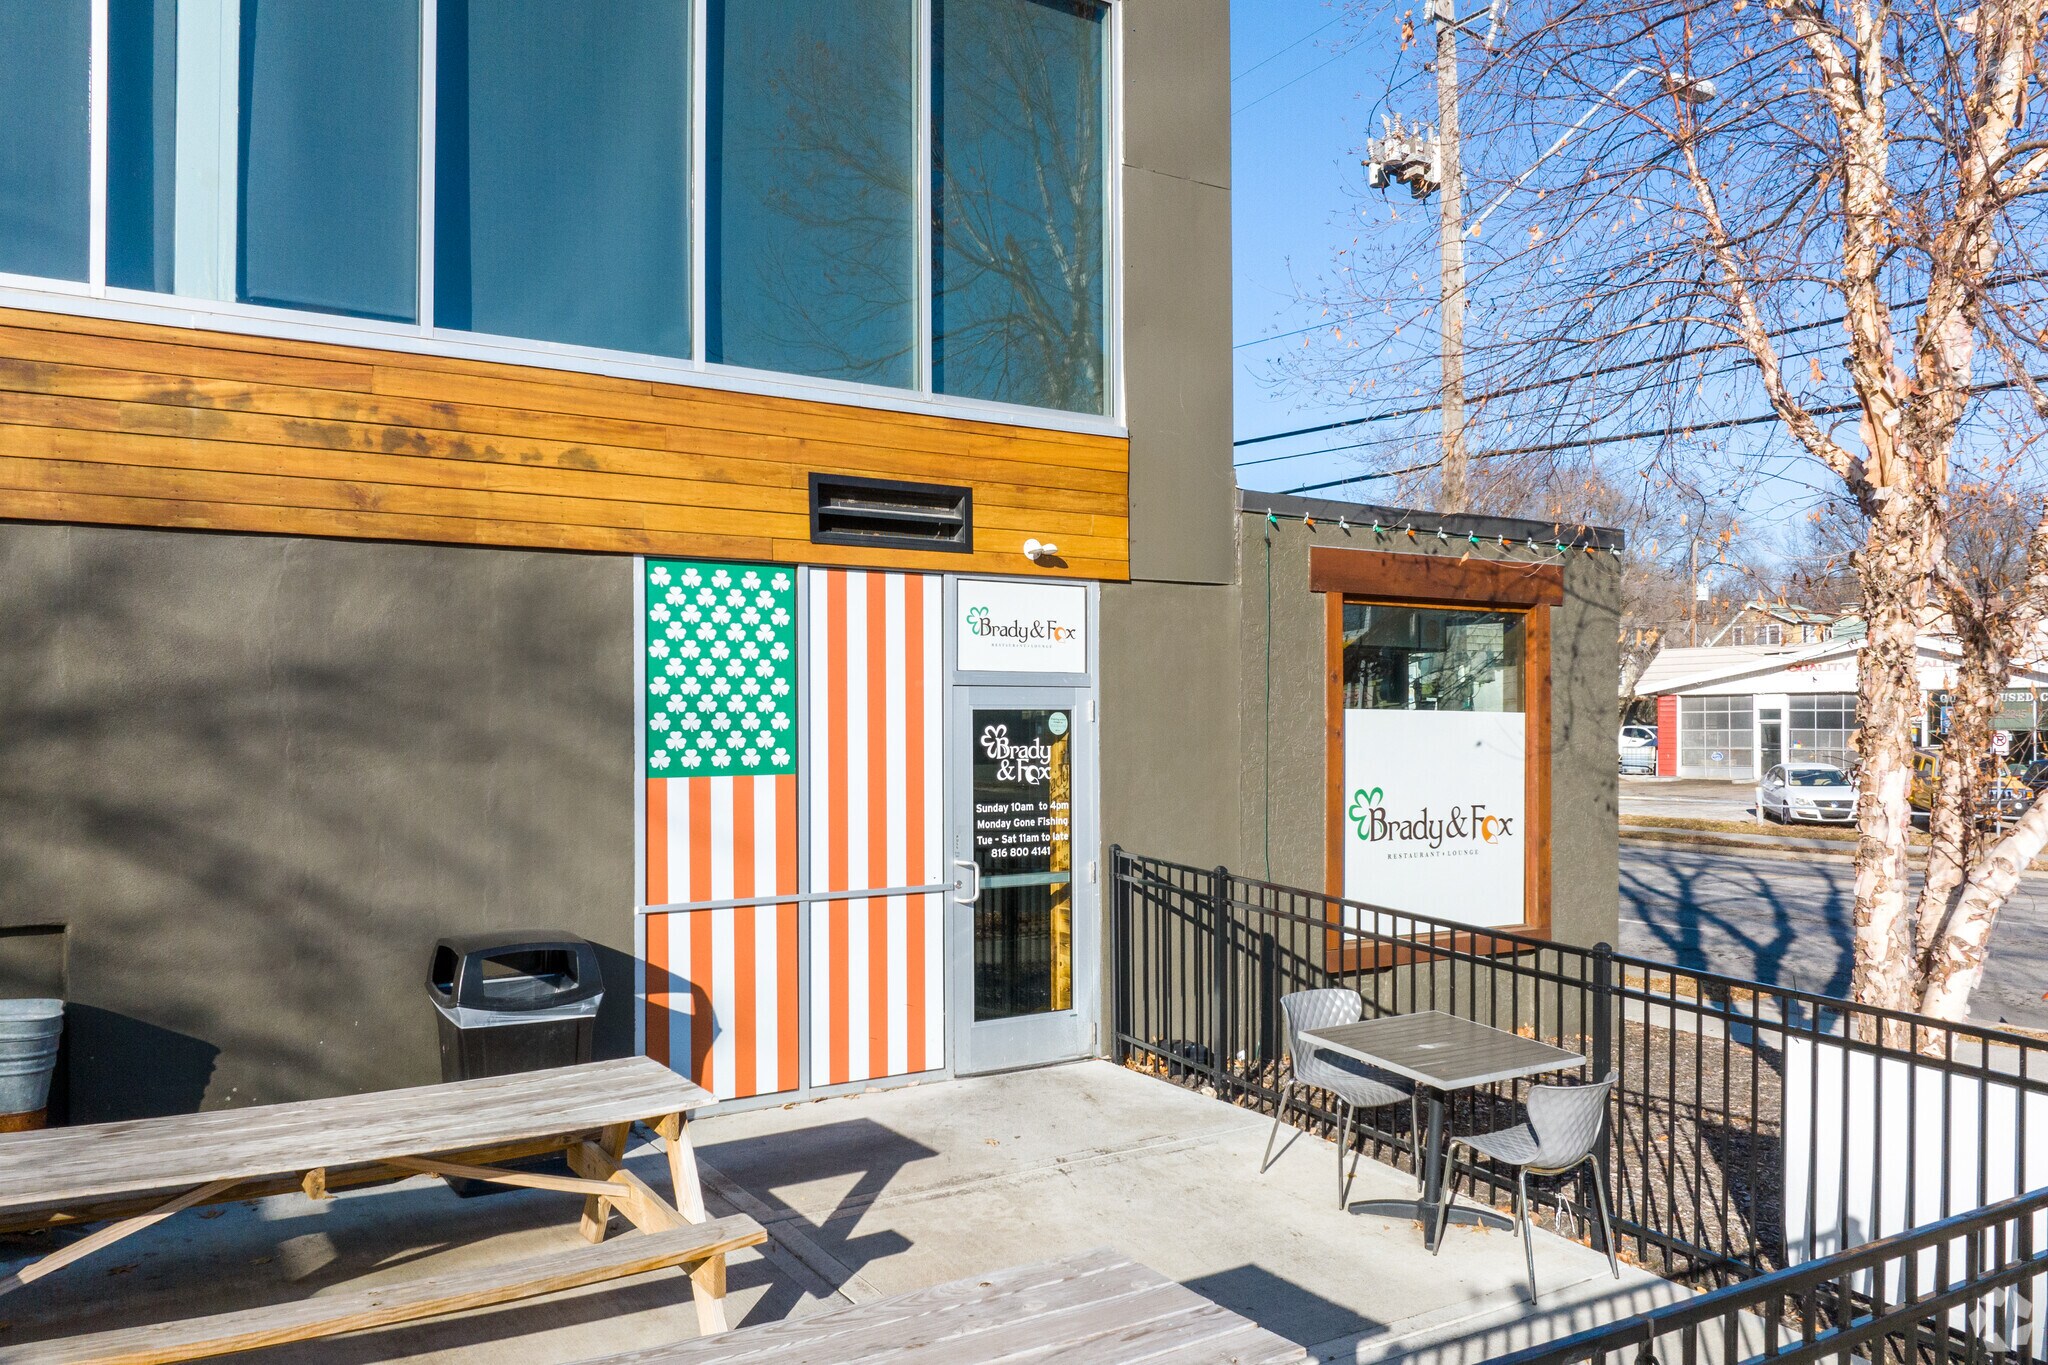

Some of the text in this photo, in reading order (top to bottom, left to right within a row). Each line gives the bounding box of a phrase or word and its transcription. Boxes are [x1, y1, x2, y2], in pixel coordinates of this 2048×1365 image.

[2000, 692, 2034, 702] USED
[995, 737, 1052, 764] Brady
[996, 759, 1016, 781] &
[1016, 758, 1052, 785] Fox
[976, 801, 1069, 814] Sunday 10am to 4pm
[977, 817, 1069, 829] Monday Gone Fishing
[976, 835, 993, 845] Tue
[1001, 834, 1017, 844] Sat
[1018, 833, 1040, 843] 11am
[1041, 832, 1050, 842] to
[1052, 831, 1069, 841] late
[991, 846, 1051, 858] 816 800 4141
[1387, 848, 1479, 860] RESTAURANT LOUNGE
